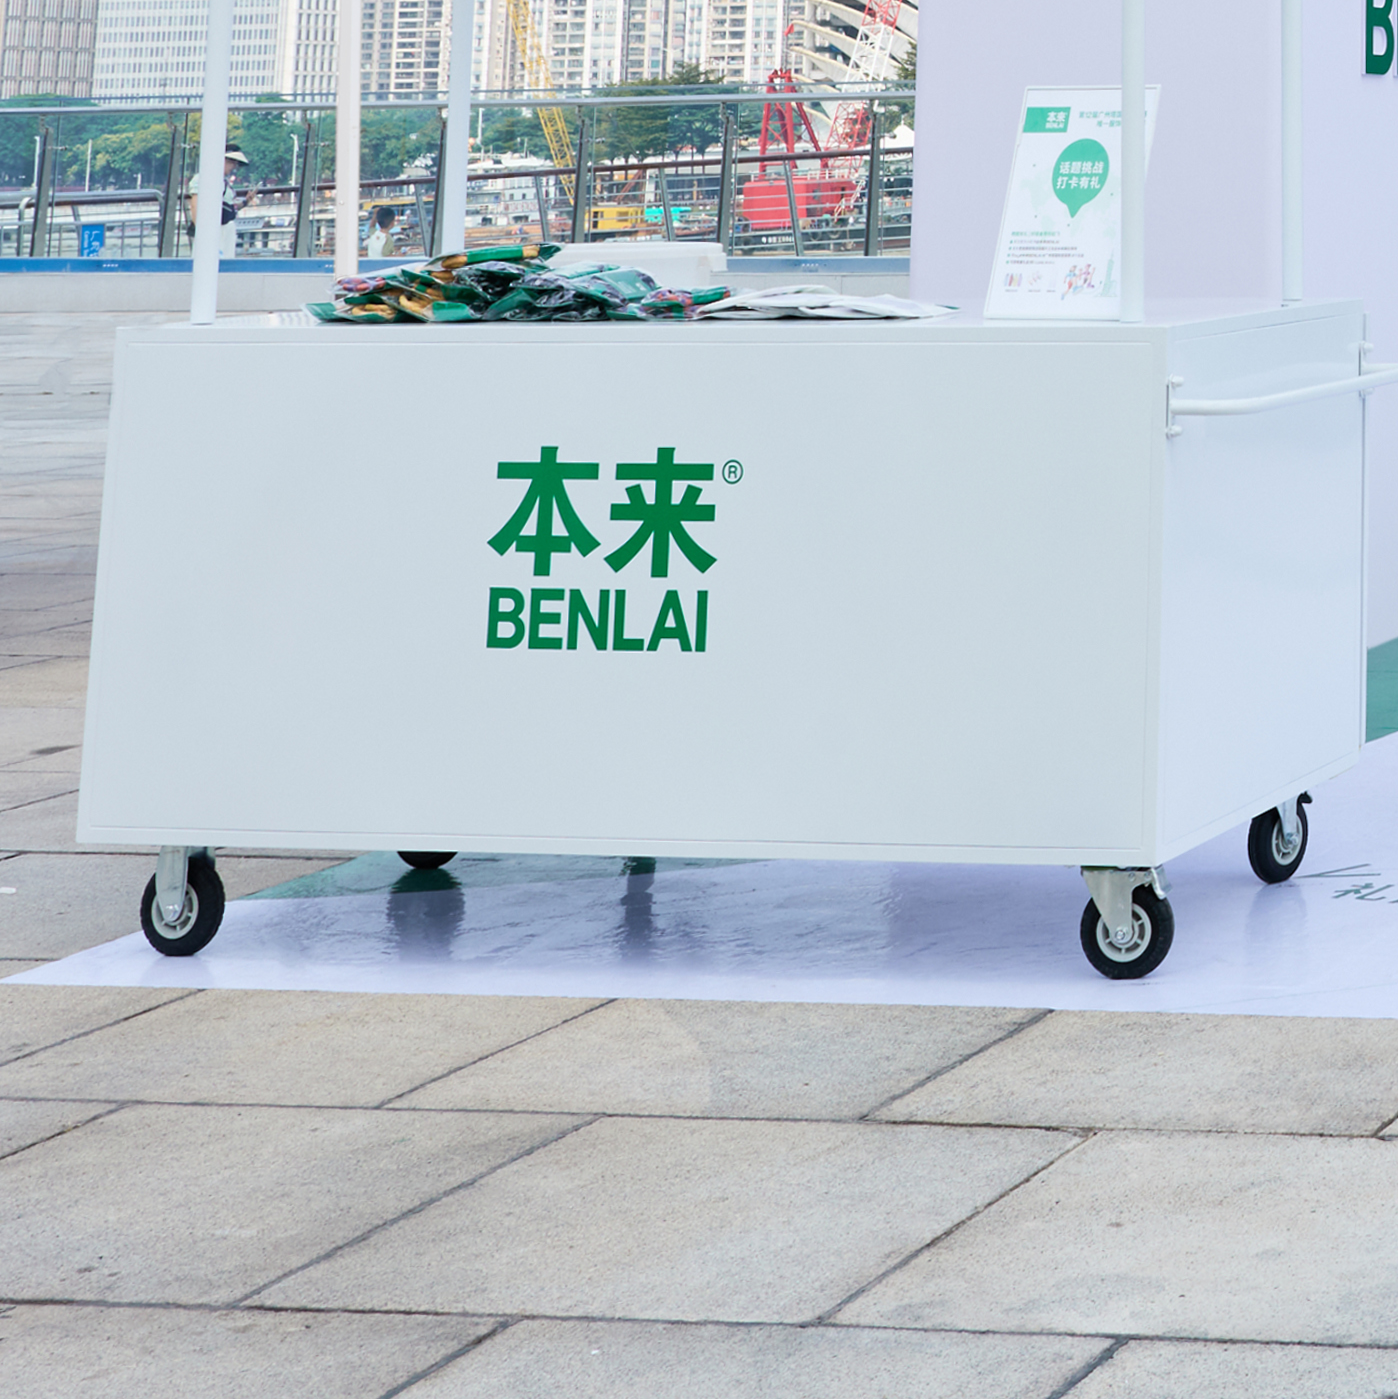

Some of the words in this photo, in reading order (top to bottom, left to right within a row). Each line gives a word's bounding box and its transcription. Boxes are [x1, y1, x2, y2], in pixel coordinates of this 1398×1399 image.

[1059, 161, 1104, 174] 话题挑战
[1056, 176, 1101, 190] 打卡有礼
[486, 586, 709, 653] BENLAI
